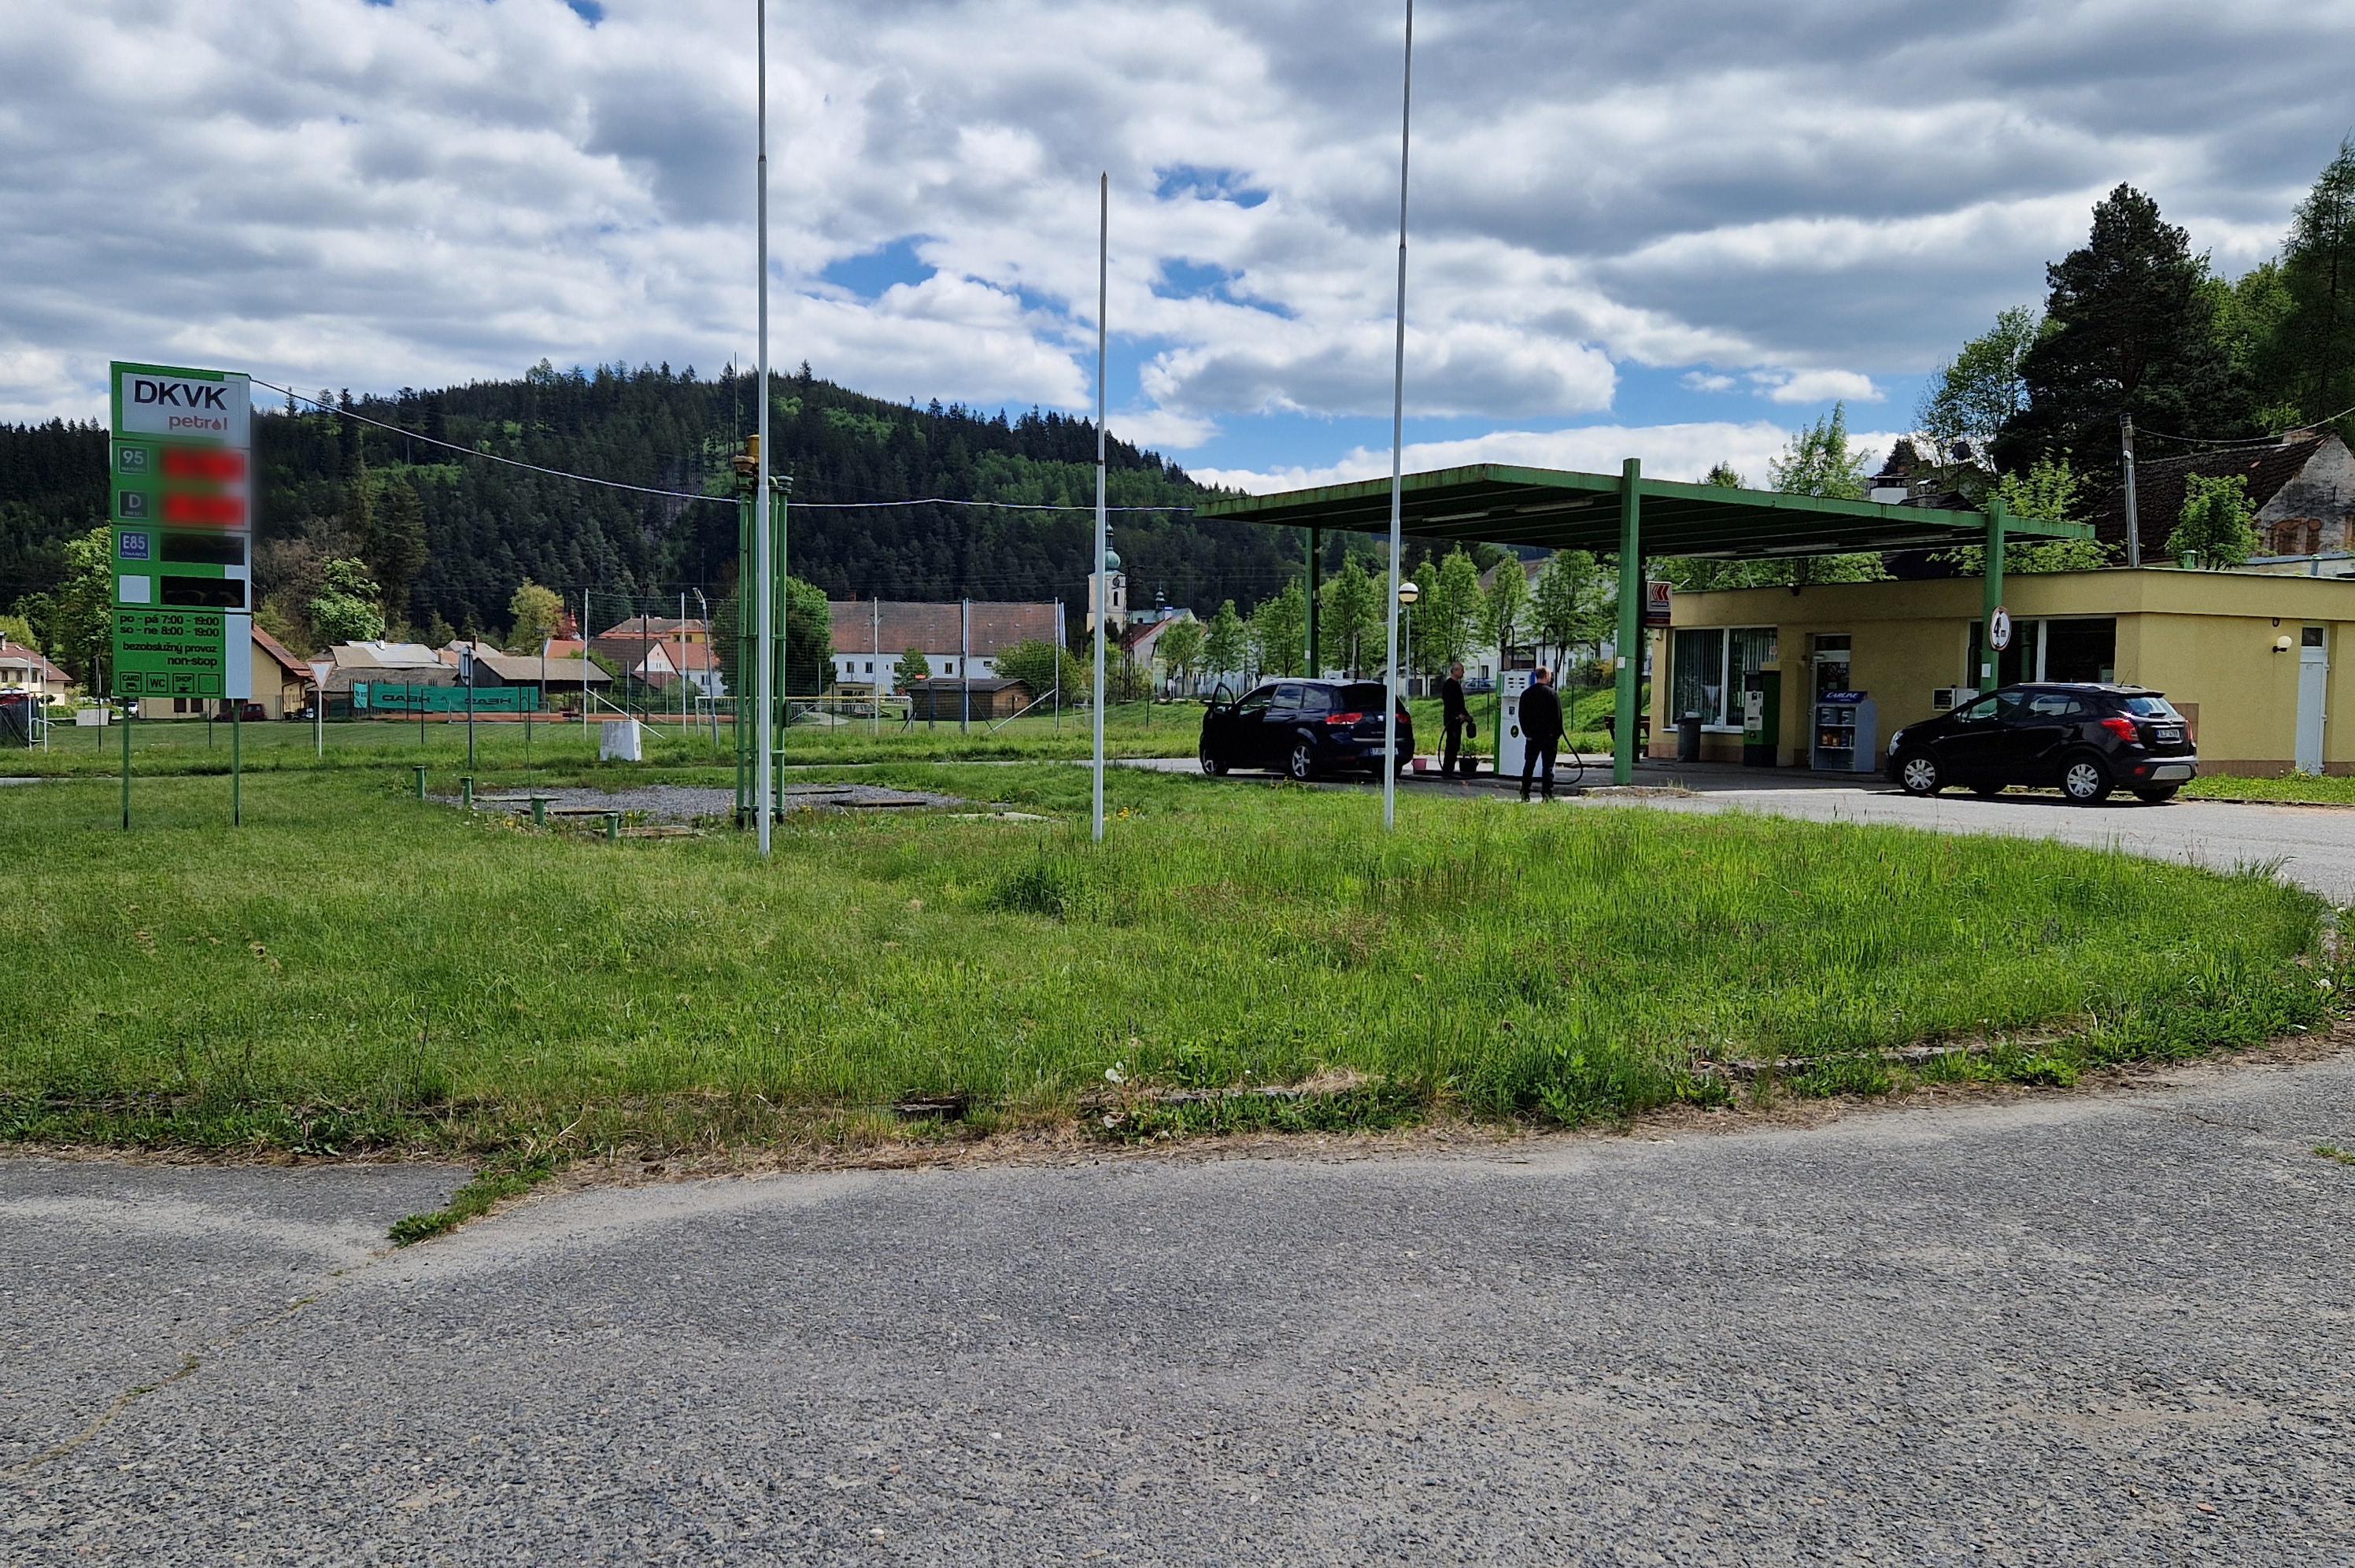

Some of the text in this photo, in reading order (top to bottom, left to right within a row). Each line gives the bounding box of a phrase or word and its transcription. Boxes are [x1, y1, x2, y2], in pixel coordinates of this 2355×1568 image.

[135, 380, 227, 410] DKVK
[123, 450, 144, 465] 95
[128, 494, 142, 508] D
[123, 534, 146, 549] E85
[120, 615, 135, 624] po
[144, 614, 159, 625] pá
[161, 615, 184, 624] 7:00
[194, 617, 220, 626] 19:00
[161, 627, 183, 635] 8:00
[194, 627, 220, 637] 19:00
[123, 642, 218, 654] bezobslužný provoz
[168, 656, 218, 669] non-stop
[150, 679, 165, 688] WC
